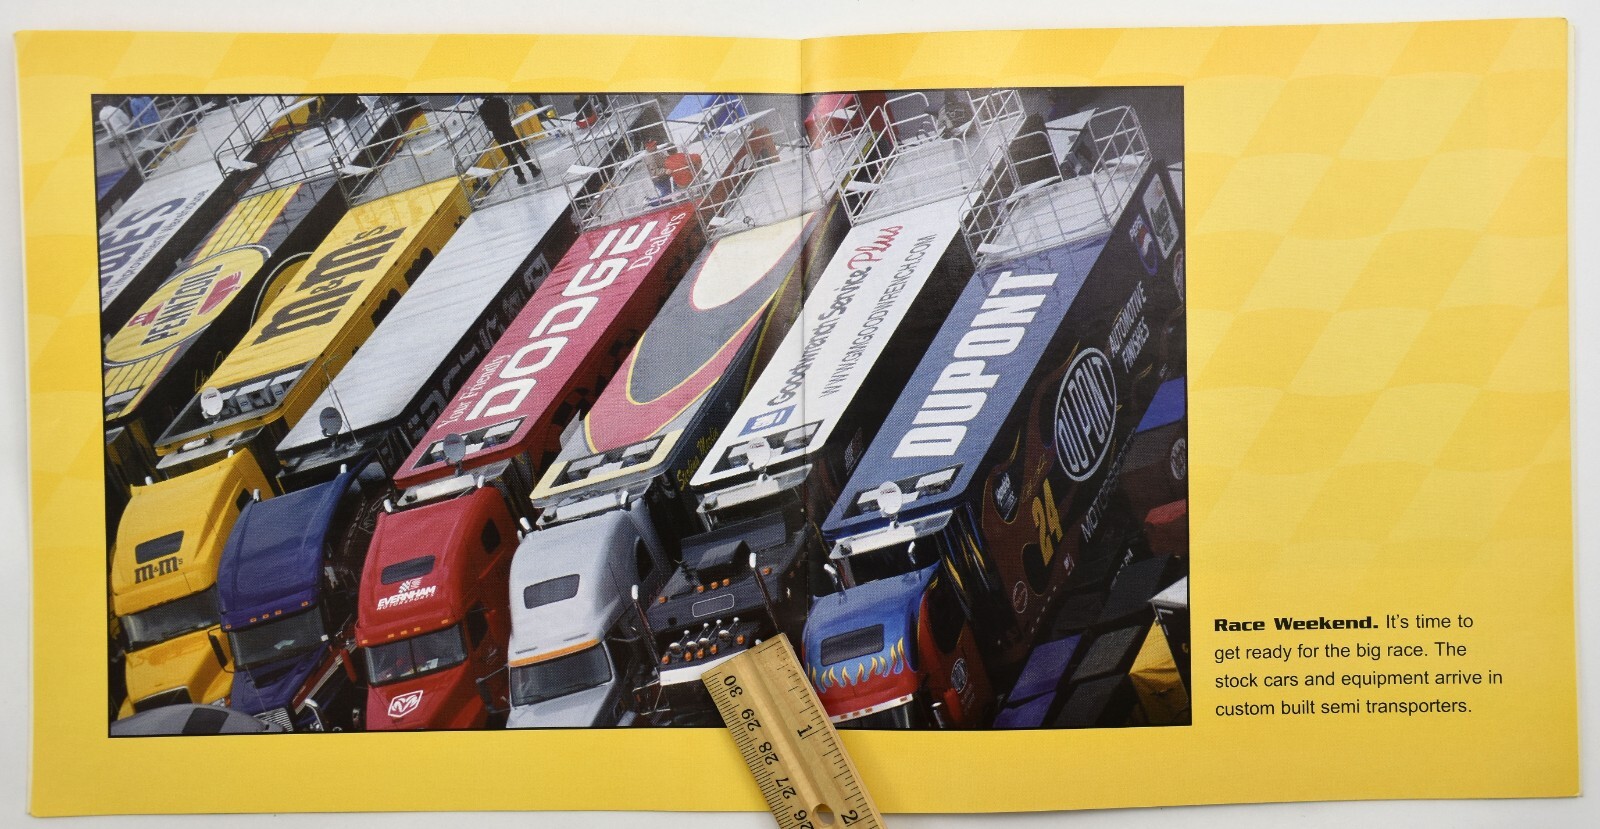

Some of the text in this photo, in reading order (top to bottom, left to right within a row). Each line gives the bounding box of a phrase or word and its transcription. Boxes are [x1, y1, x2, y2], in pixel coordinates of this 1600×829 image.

[628, 211, 687, 272] Dealers
[141, 264, 224, 346] PENNZOIL
[767, 317, 840, 407] Goodwrench
[817, 266, 872, 322] Service
[847, 225, 903, 270] Plus
[465, 220, 659, 422] DODGE
[1108, 281, 1148, 358] AUTOMOTIVE
[1121, 316, 1151, 374] FINISHES
[891, 271, 1060, 459] DUPONT
[437, 400, 469, 430] Your
[459, 354, 512, 401] Friendly
[1057, 355, 1115, 474] DUPONT
[1031, 477, 1063, 567] 24
[377, 585, 437, 608] EVERNHAM
[1213, 613, 1475, 632] Race Weekend. It's time to
[1213, 641, 1468, 664] get ready for the big race. The
[723, 675, 744, 698] 30
[1214, 669, 1504, 689] stock cars and equipment arrive in
[1214, 698, 1473, 717] custom built semi transporters.
[741, 708, 762, 732] 29
[797, 724, 813, 738] 1
[758, 741, 779, 765] 28
[775, 777, 797, 799] 27
[840, 809, 859, 825] 2
